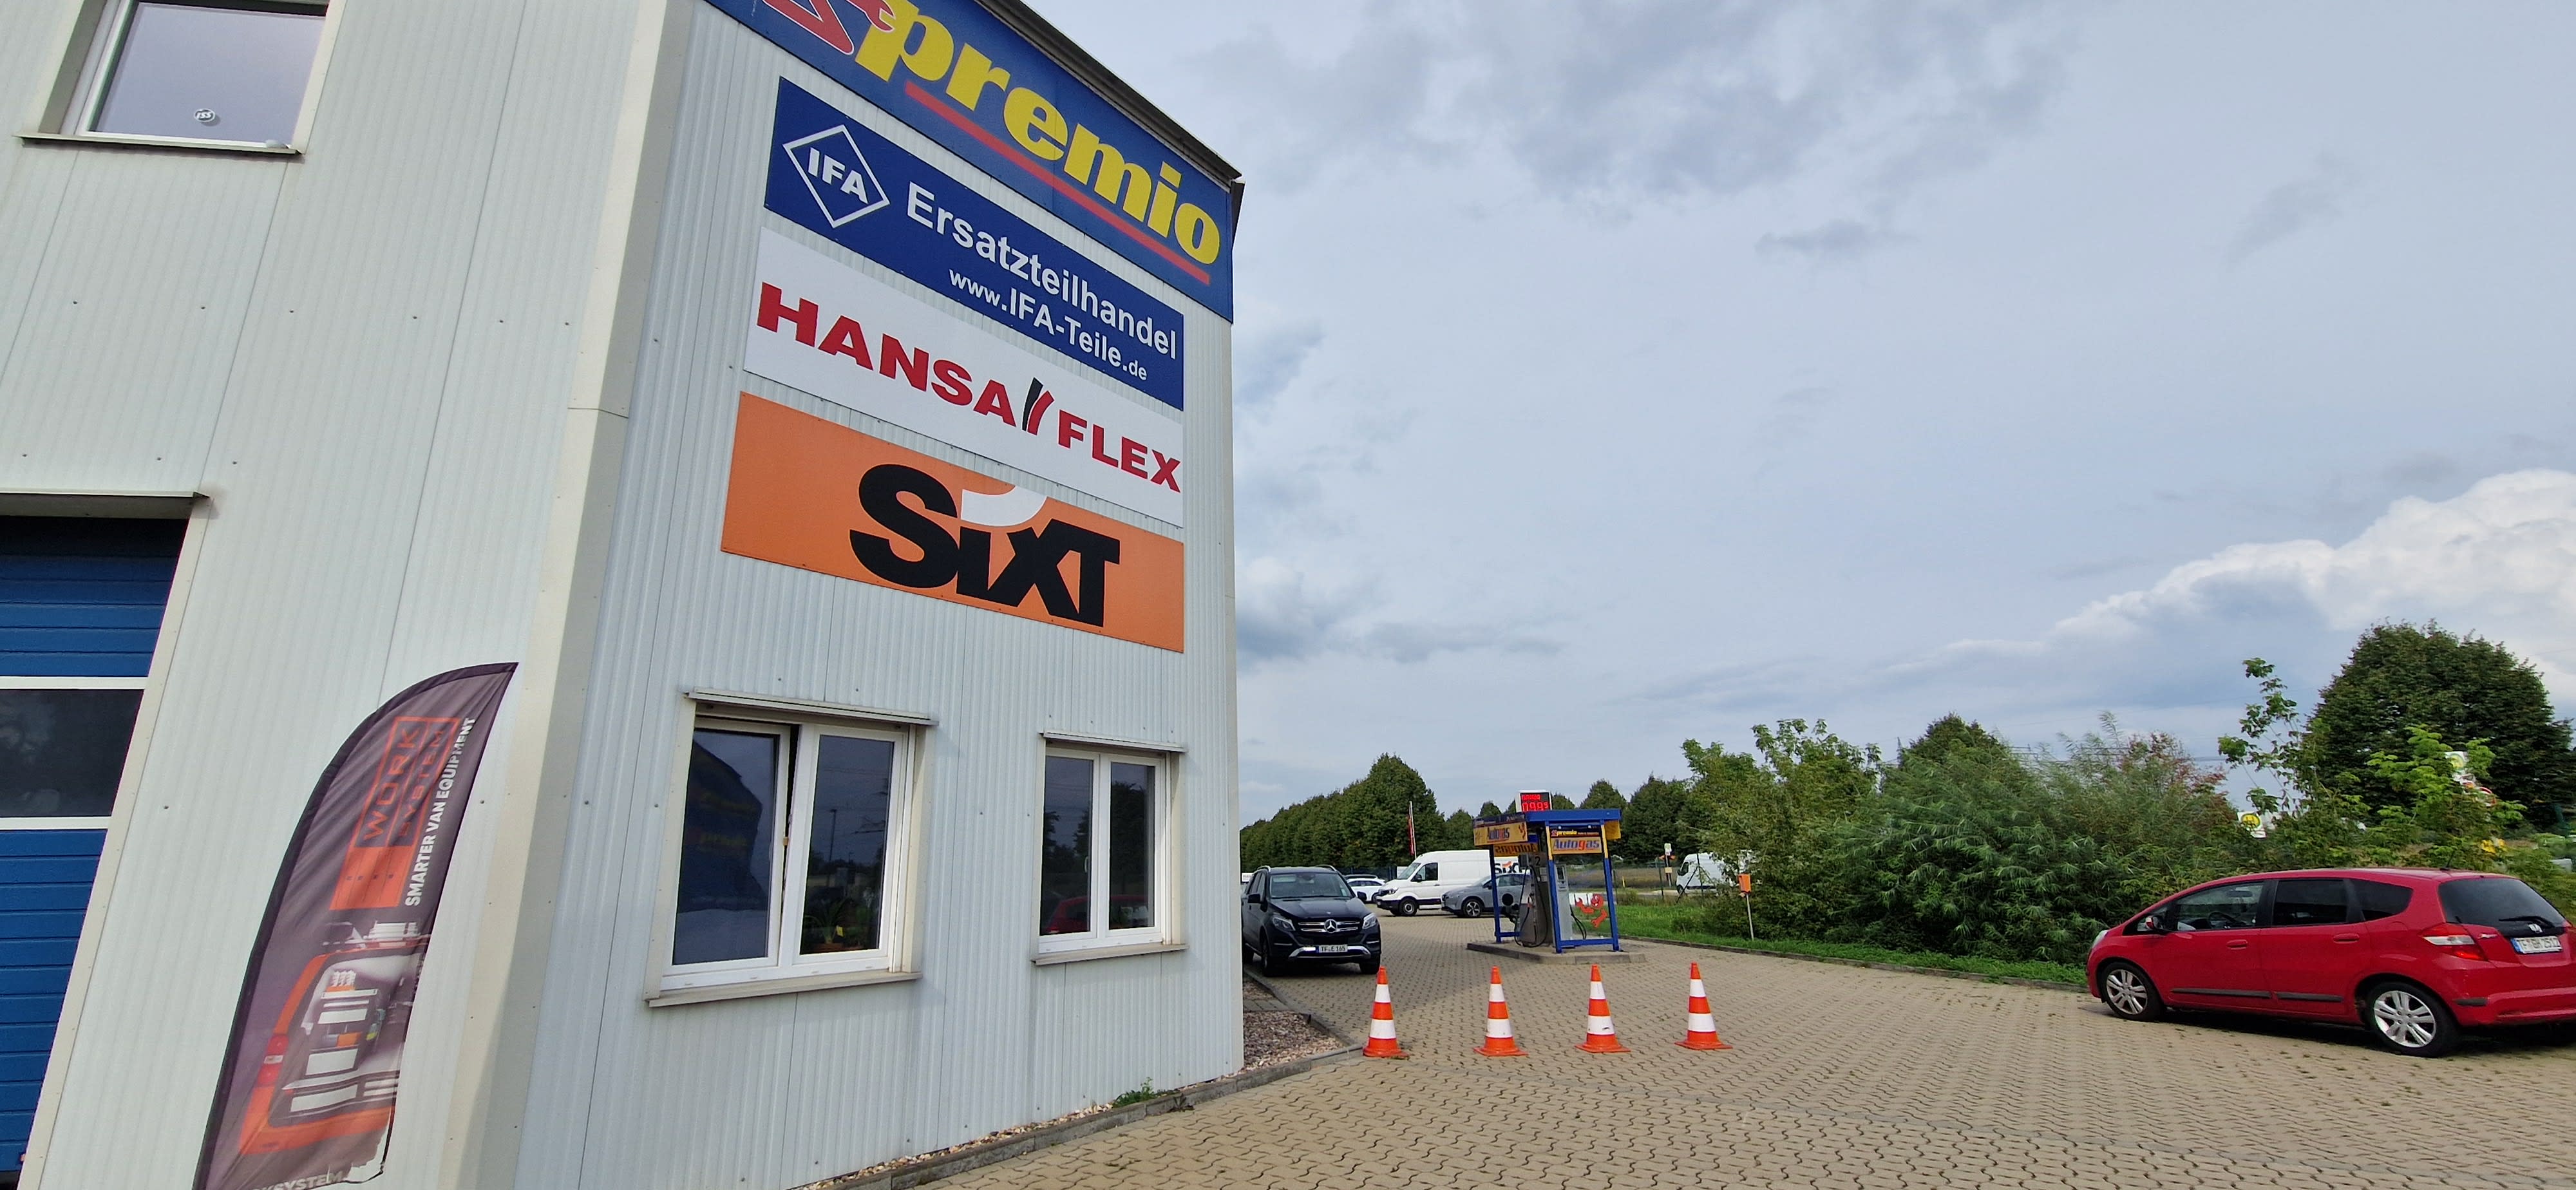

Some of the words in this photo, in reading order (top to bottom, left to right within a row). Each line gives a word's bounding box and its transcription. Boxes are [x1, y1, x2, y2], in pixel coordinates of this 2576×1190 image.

[807, 147, 869, 204] IFA
[855, 0, 1220, 265] premio
[906, 181, 1177, 360] Ersatzteilhandel
[949, 268, 1148, 381] www.IFA-Teile.de
[756, 281, 1016, 426] HANSA
[1057, 408, 1182, 493] FLEX
[849, 463, 1121, 627] SIXT
[363, 727, 419, 840] WORK
[398, 730, 443, 836] SYSTEM
[435, 717, 476, 800] EQUIPMENT
[404, 835, 437, 907] SMARTER
[426, 802, 447, 835] VAN
[1535, 856, 1541, 866] 2
[1553, 838, 1600, 851] Autogas
